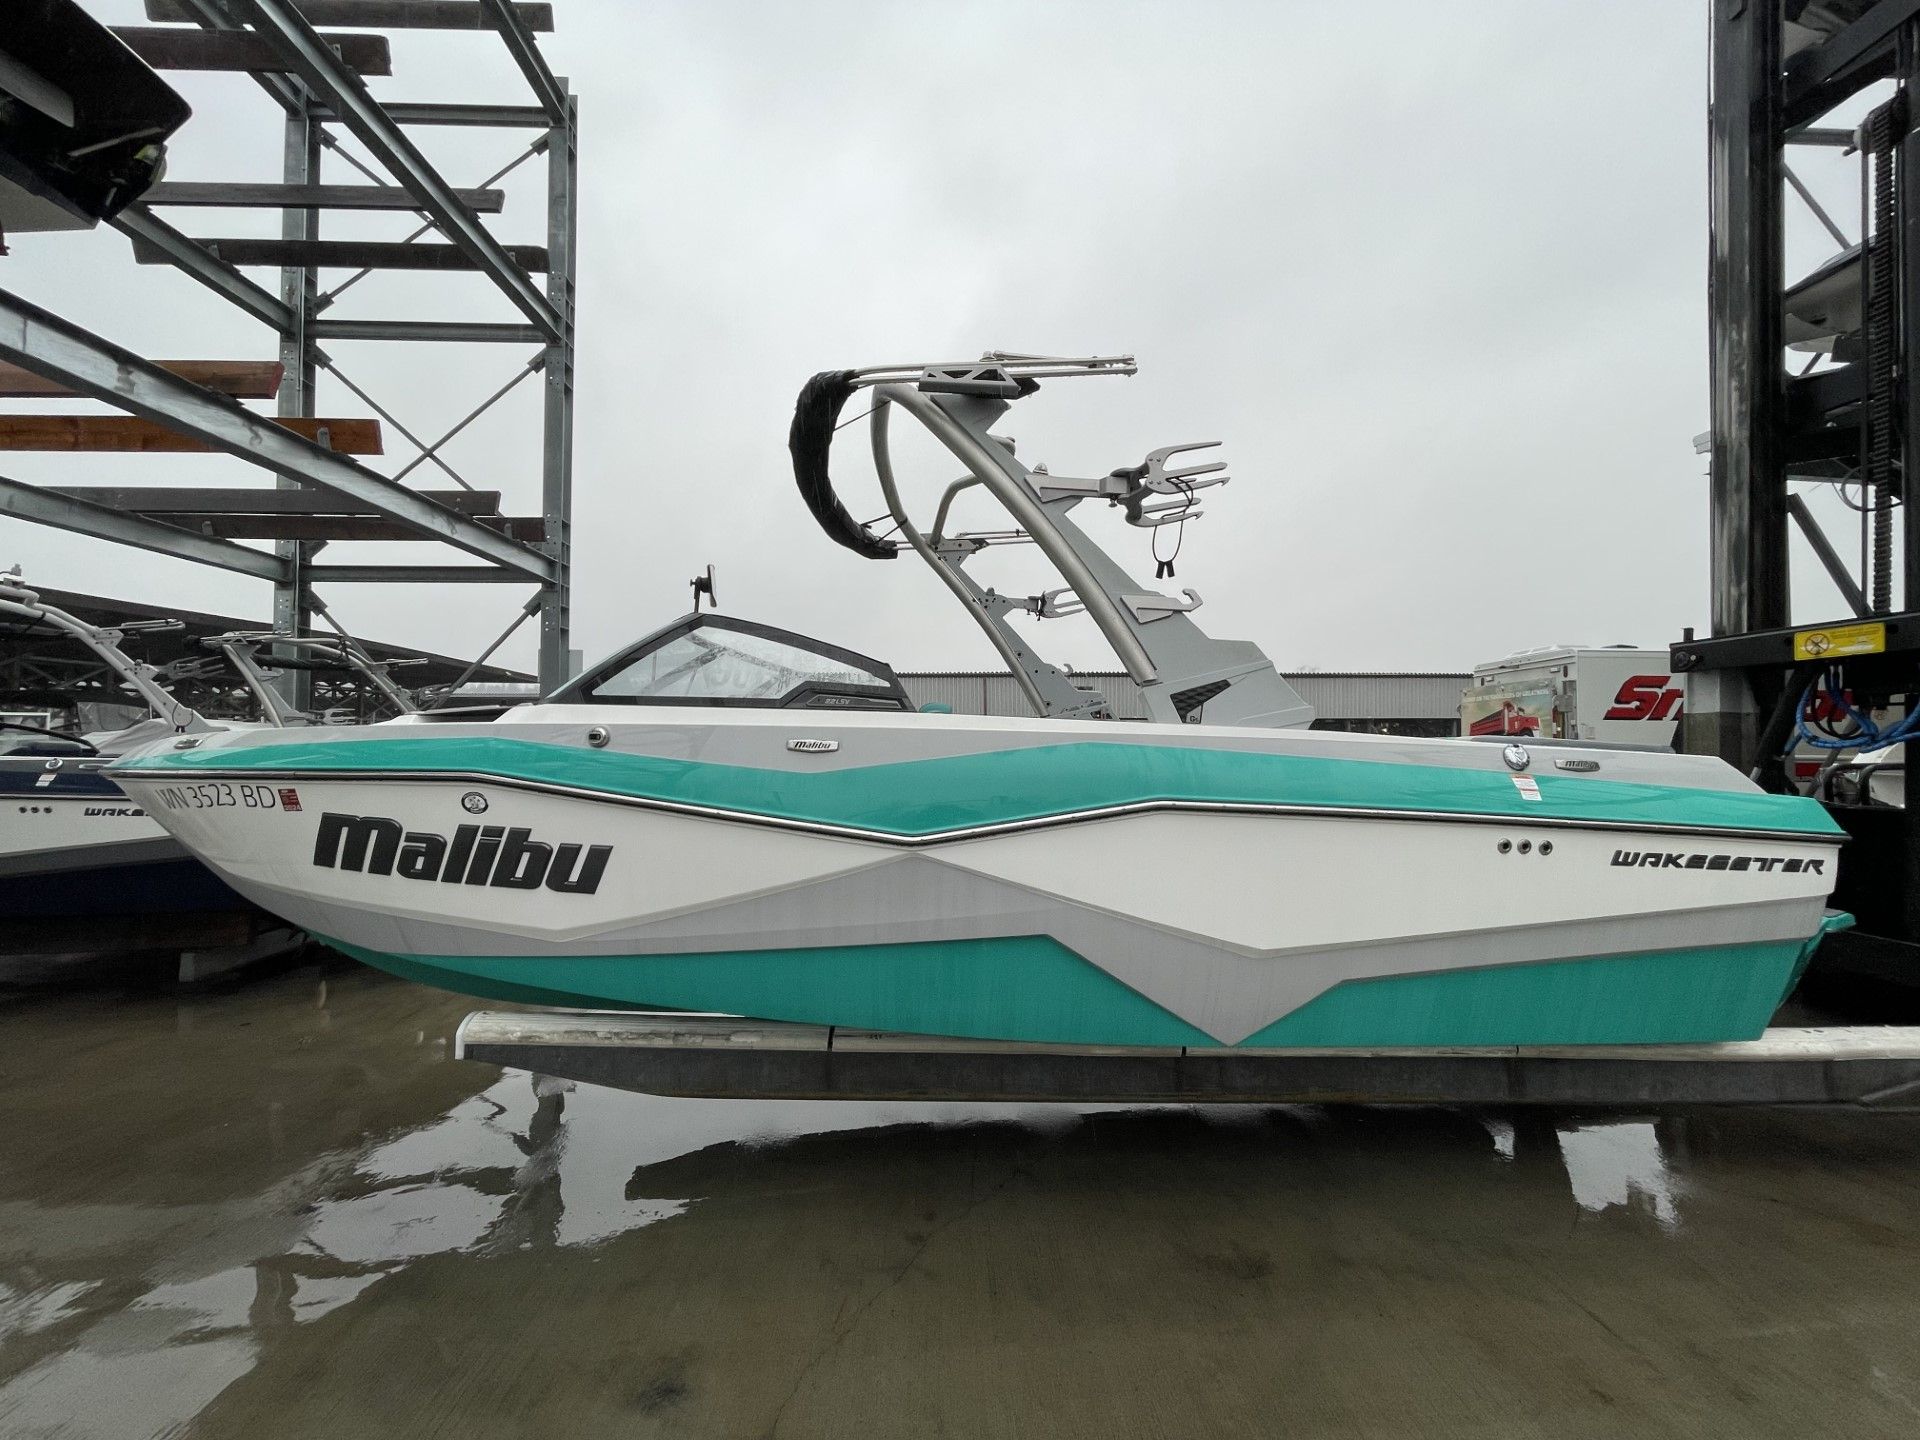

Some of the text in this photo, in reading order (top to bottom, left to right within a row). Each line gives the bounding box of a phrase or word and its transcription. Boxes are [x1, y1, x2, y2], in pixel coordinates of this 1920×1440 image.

[794, 741, 831, 749] Malibu
[187, 783, 237, 808] 3523
[240, 785, 276, 808] BD
[313, 812, 614, 895] Malibu
[1610, 850, 1825, 876] WAKESETTER
